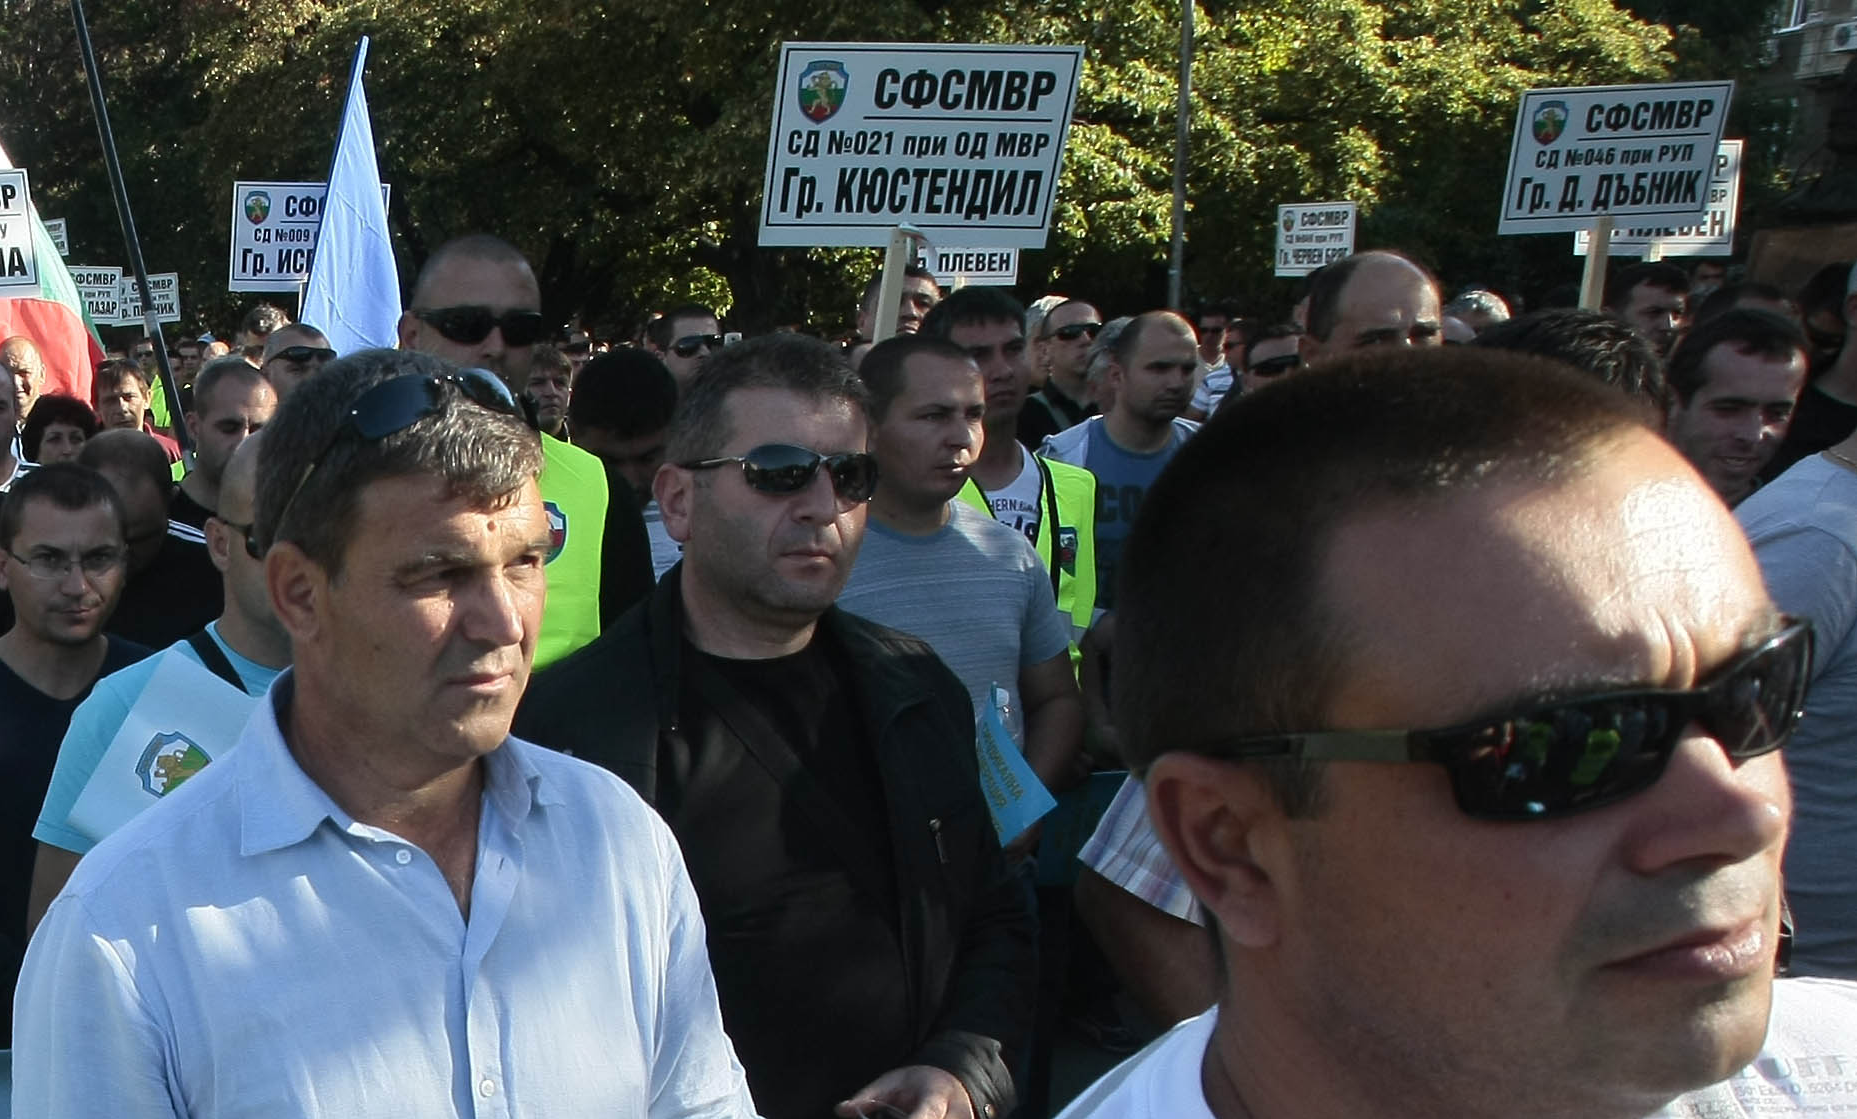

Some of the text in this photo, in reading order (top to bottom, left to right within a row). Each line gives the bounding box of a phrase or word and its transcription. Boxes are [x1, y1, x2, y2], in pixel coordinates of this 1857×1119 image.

[874, 68, 1057, 112] СФСМВР
[1585, 99, 1715, 134] СФСМВР
[788, 129, 1050, 160] СД №021 при ОД МВР
[1535, 143, 1696, 170] СД №046 при РУП
[779, 167, 1043, 220] Гр. КЮСТЕНДИЛ
[1515, 169, 1703, 214] Гр. Д. ДЪБНИК
[1301, 211, 1349, 227] СФСМВР
[254, 228, 271, 244] СД
[241, 248, 270, 277] Гр.
[938, 253, 1012, 272] ПЛЕВЕН
